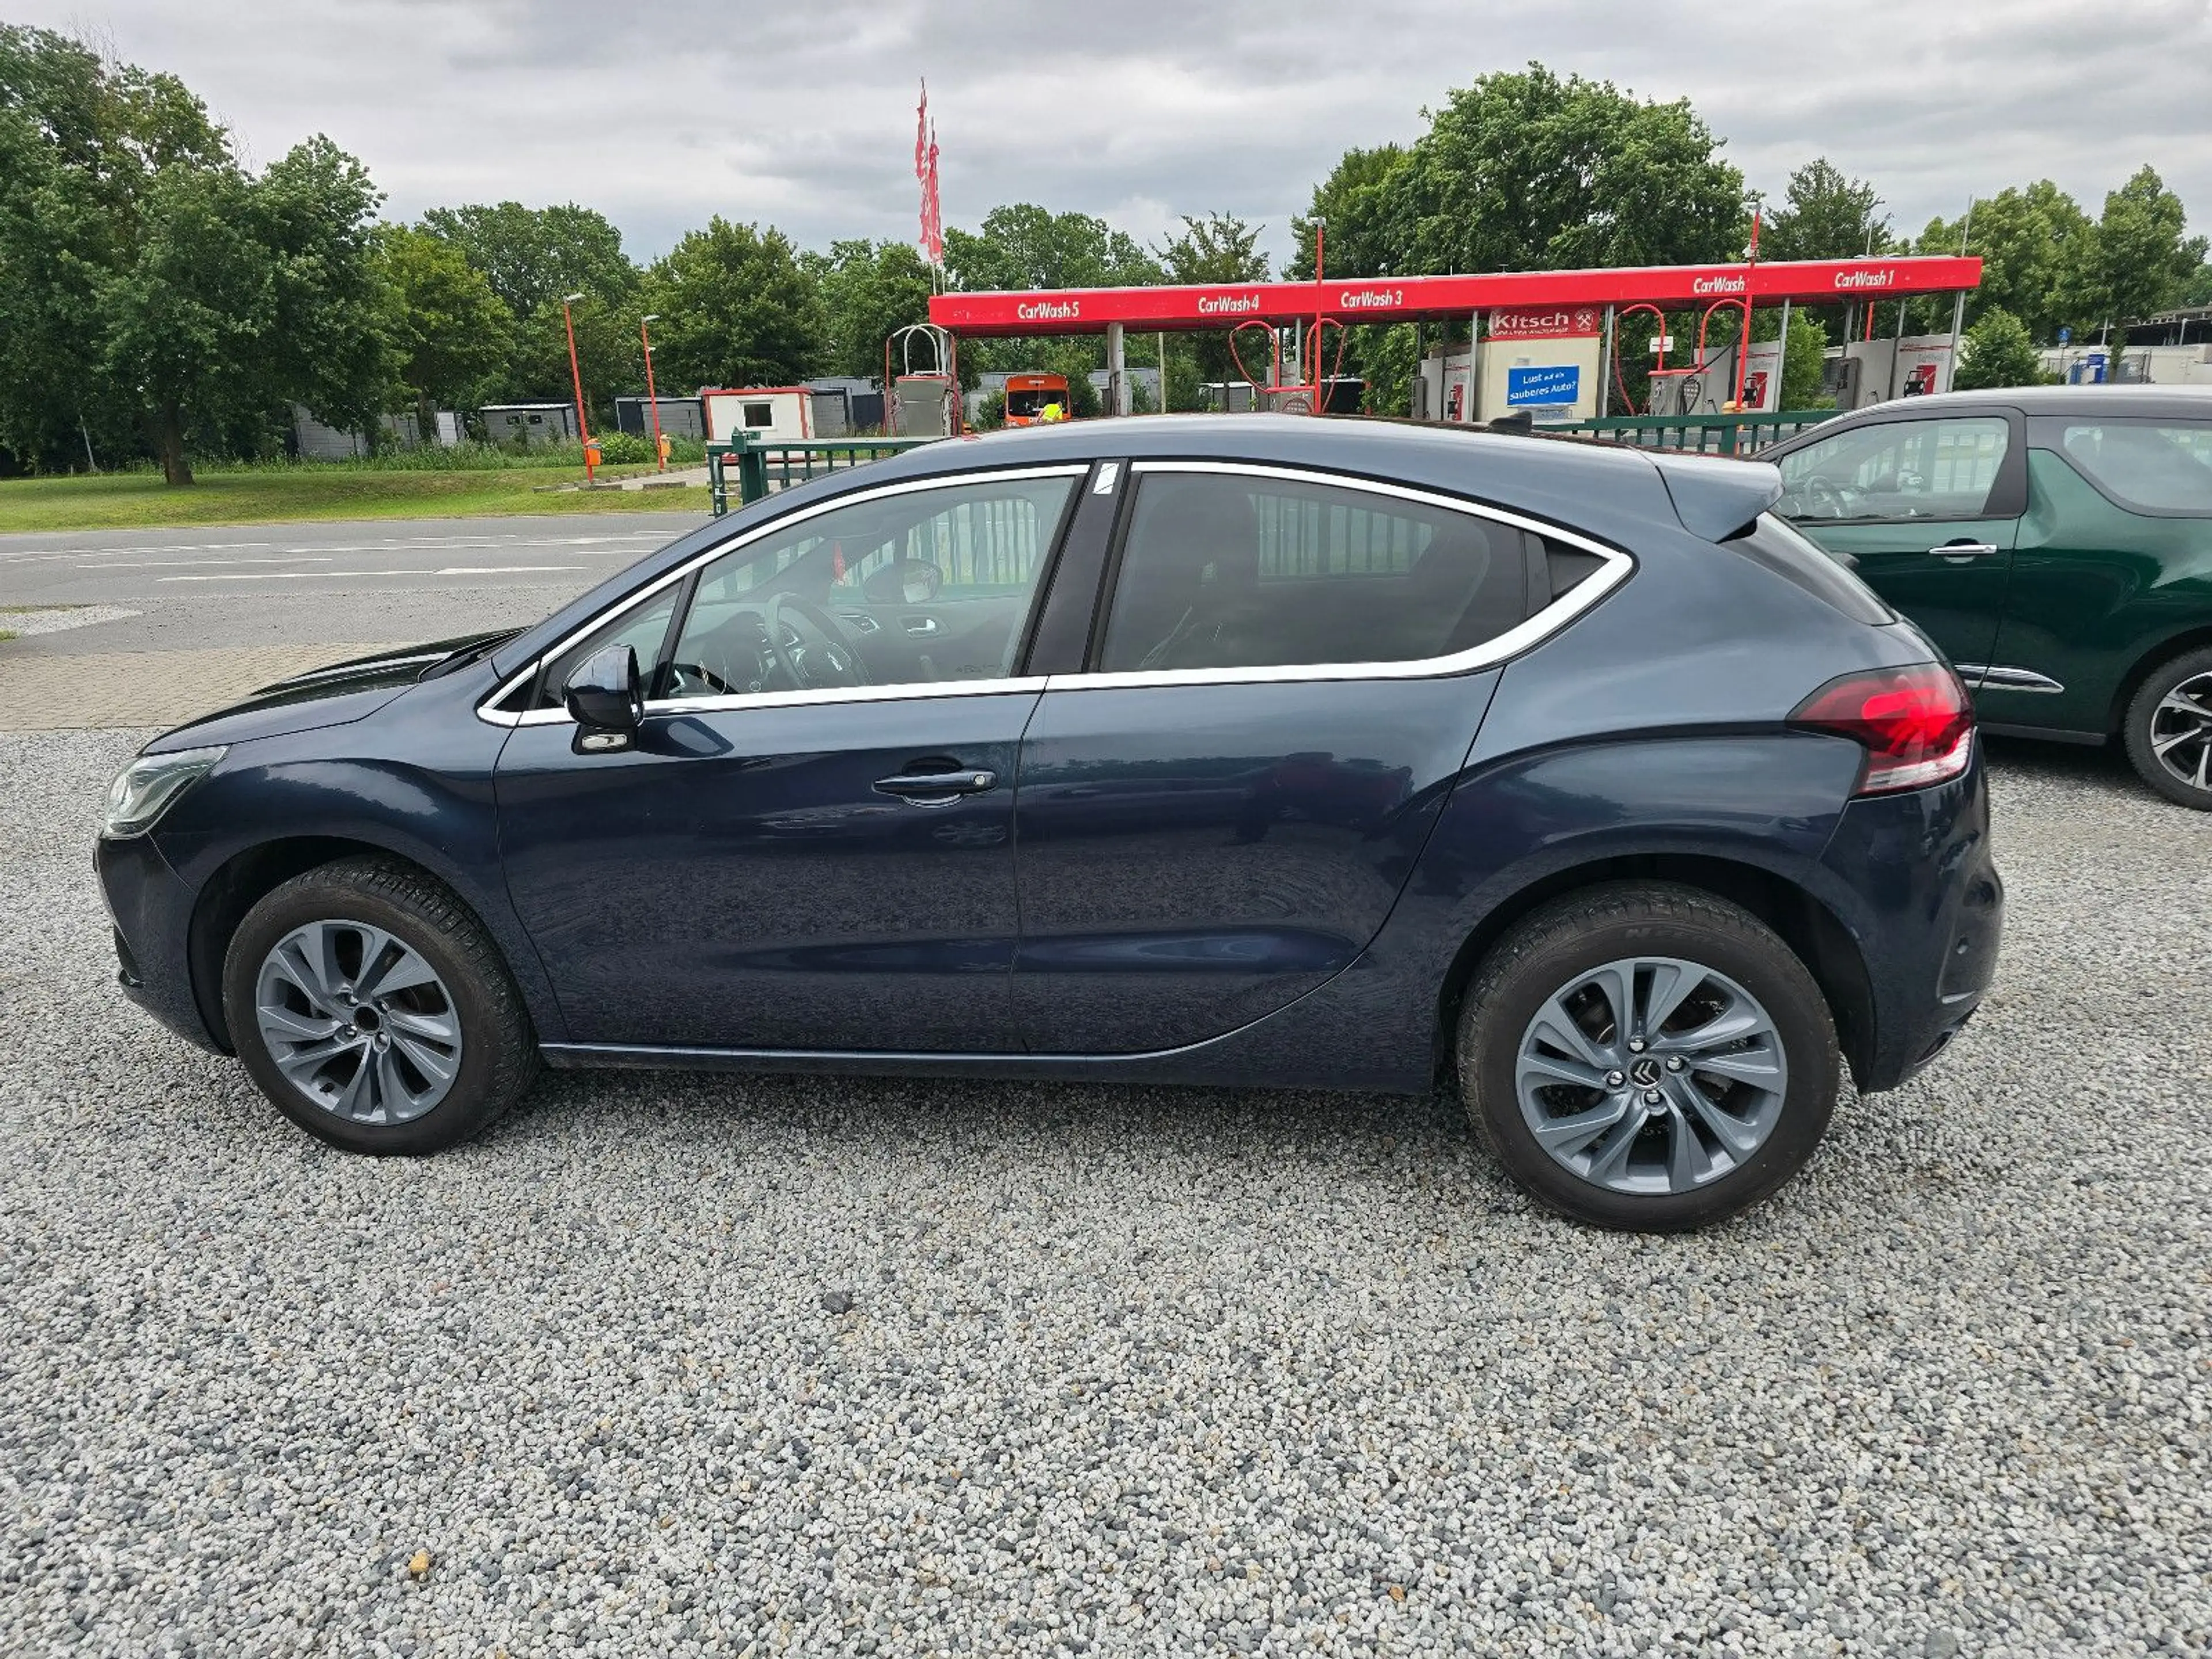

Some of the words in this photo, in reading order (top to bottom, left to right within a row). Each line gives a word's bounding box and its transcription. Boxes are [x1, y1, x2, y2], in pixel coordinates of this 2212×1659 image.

[1694, 275, 1745, 293] CarWash
[1835, 270, 1887, 288] CarWash
[1888, 269, 1895, 286] 1
[1198, 294, 1250, 313] CarWash
[1251, 294, 1260, 310] 4
[1340, 289, 1393, 308] CarWash
[1395, 290, 1403, 305] 3
[1017, 301, 1071, 319] CarWash
[1071, 301, 1080, 317] 5
[1495, 312, 1569, 329] Kitsch
[1523, 373, 1542, 384] Lust
[1509, 387, 1550, 400] sauberes
[1550, 380, 1577, 393] Auto?
